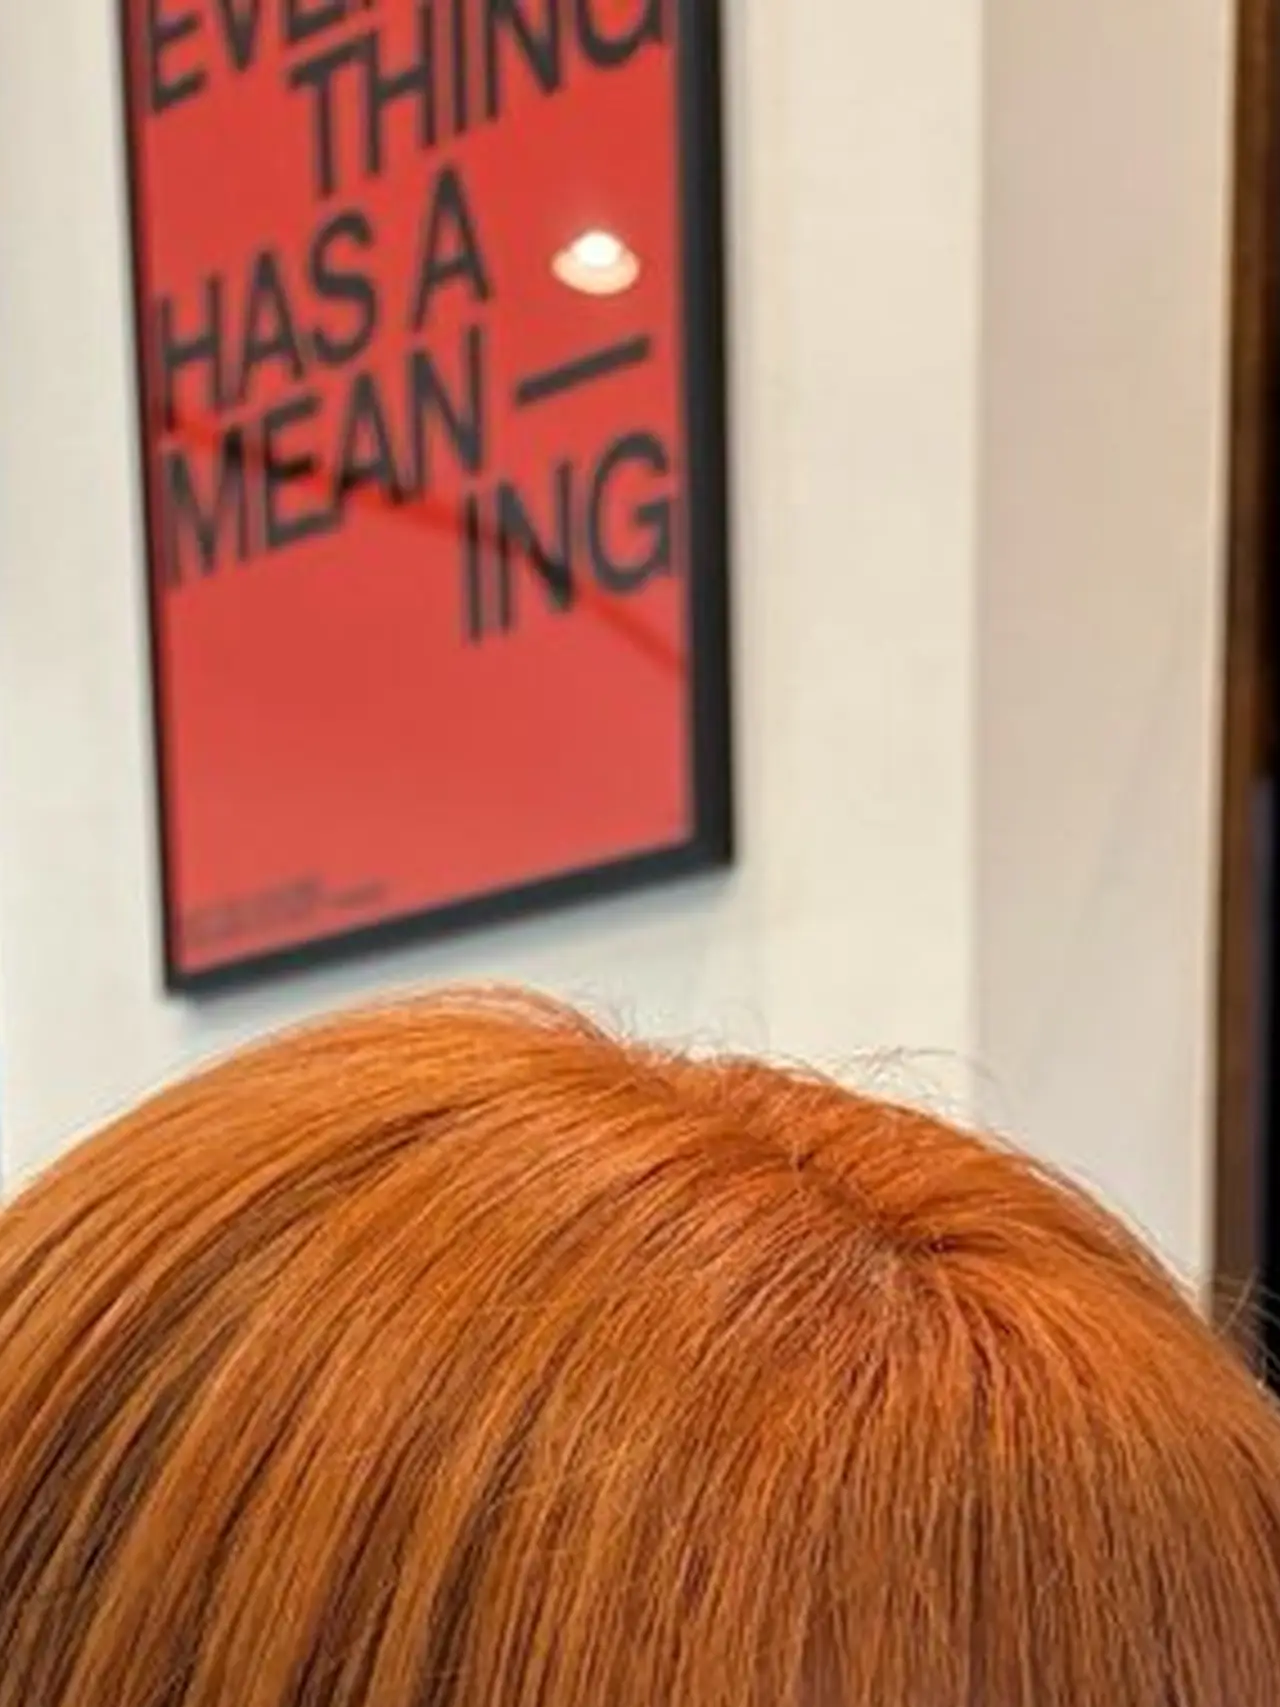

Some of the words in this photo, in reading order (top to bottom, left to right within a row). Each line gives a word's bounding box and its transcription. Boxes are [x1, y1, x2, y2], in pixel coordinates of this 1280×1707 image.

[156, 210, 377, 434] HAS
[410, 166, 490, 334] A
[159, 322, 484, 592] MEAN
[463, 430, 673, 646] ING
